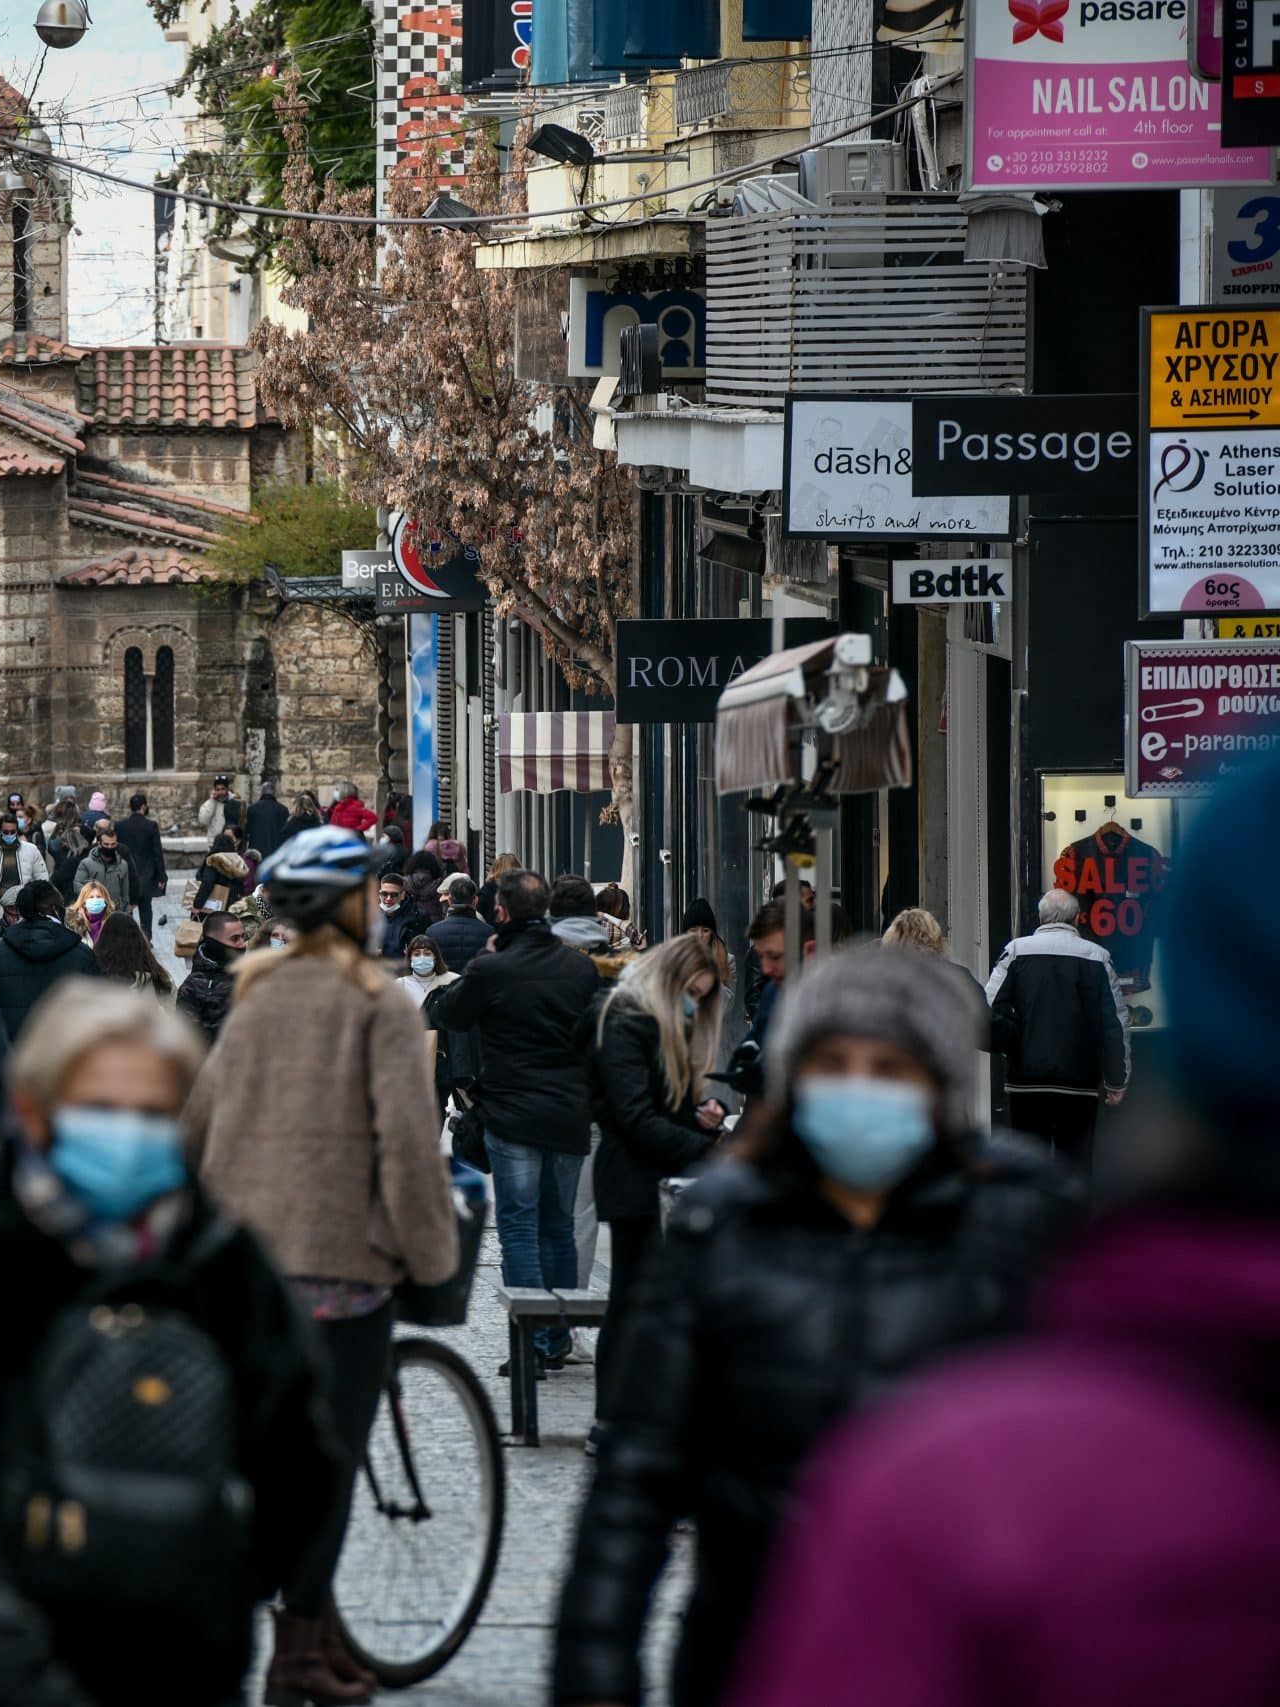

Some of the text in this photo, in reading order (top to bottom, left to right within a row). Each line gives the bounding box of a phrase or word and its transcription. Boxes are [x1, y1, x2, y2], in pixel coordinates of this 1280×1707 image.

[1032, 75, 1209, 114] NAIL SALON
[988, 127, 1004, 138] For
[1007, 127, 1071, 140] appointment
[1073, 124, 1092, 137] call
[1134, 119, 1193, 134] 4th floor
[1031, 151, 1053, 162] 210
[1175, 319, 1269, 349] ΑΓΟΡΑ
[1165, 353, 1279, 383] ΧΡΥΣΟΥ
[1171, 387, 1272, 407] & ΑΣΗΜΙΟΥ
[938, 420, 1132, 472] Passage
[1220, 444, 1280, 459] Athens
[1226, 462, 1275, 477] Laser
[1214, 481, 1280, 496] Solutio
[816, 508, 977, 530] shirts and more
[1153, 521, 1280, 536] Μόνιμης Αποτρίχωσ
[1199, 545, 1223, 557] 210
[909, 566, 1005, 598] Bdtk
